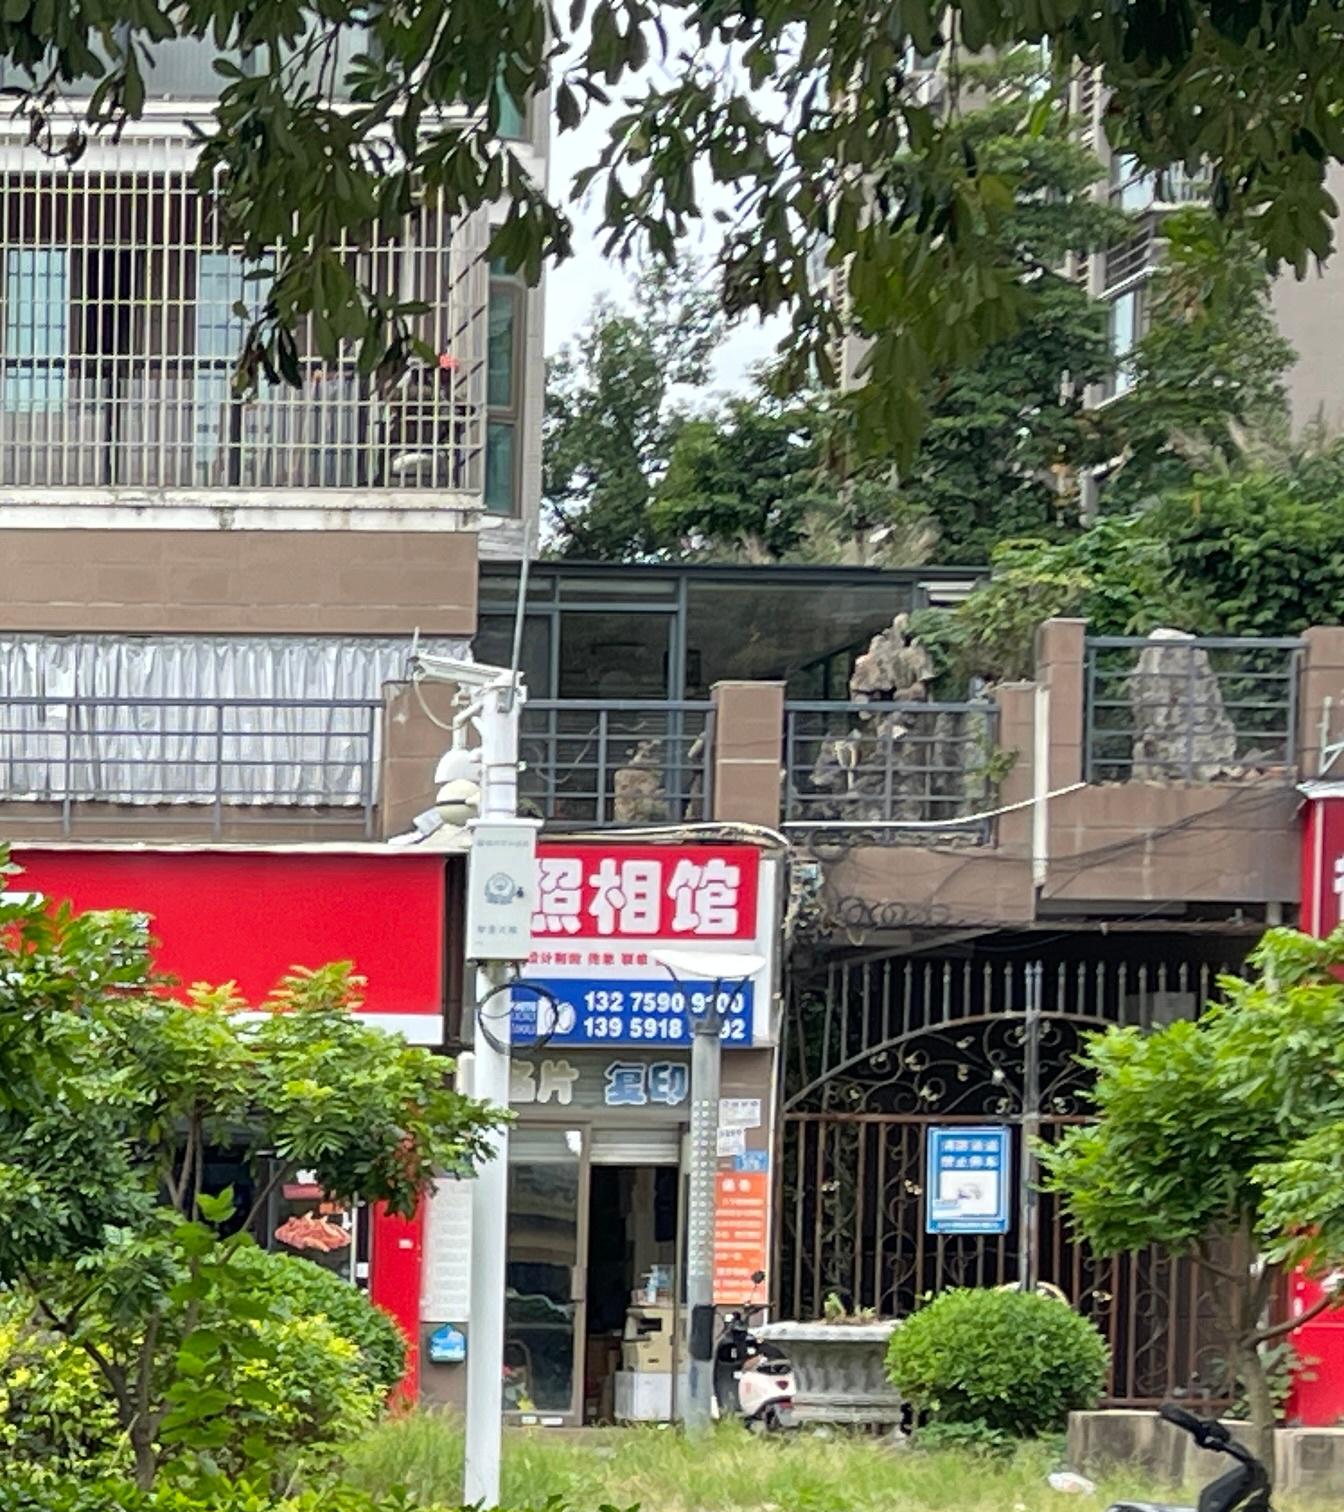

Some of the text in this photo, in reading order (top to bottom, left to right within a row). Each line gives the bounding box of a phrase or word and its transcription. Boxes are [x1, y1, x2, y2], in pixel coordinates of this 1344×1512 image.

[531, 857, 741, 935] 照相馆
[584, 988, 746, 1014] 132 7590 900
[583, 1016, 624, 1039] 139
[629, 1017, 683, 1039] 5918
[604, 1060, 690, 1107] 复印
